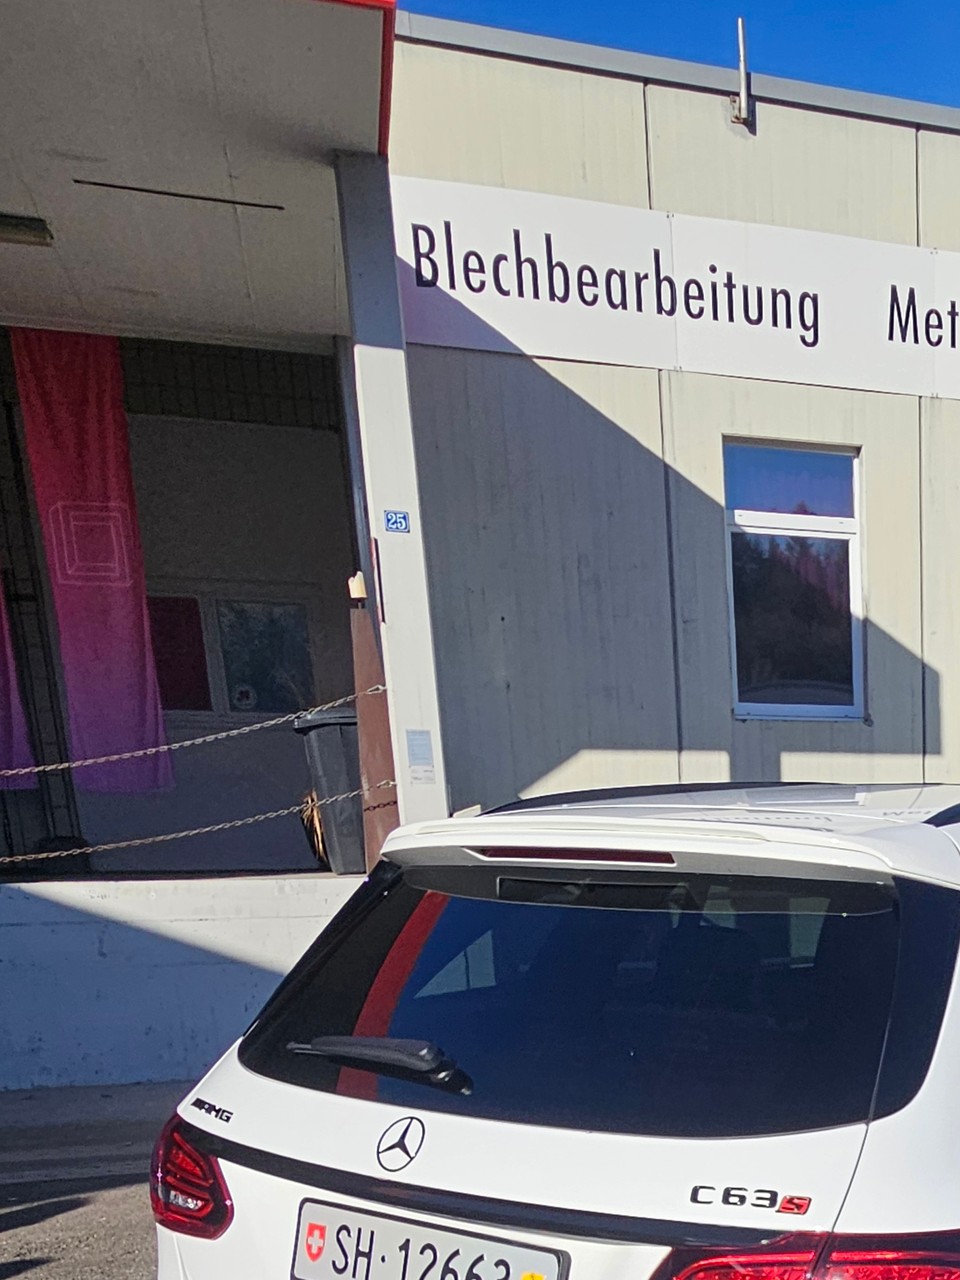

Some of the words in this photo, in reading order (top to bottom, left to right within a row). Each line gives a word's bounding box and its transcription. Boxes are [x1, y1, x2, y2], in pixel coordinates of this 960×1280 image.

[412, 221, 820, 348] Blechbearbeitung
[387, 512, 407, 530] 25
[191, 1097, 234, 1123] AMG
